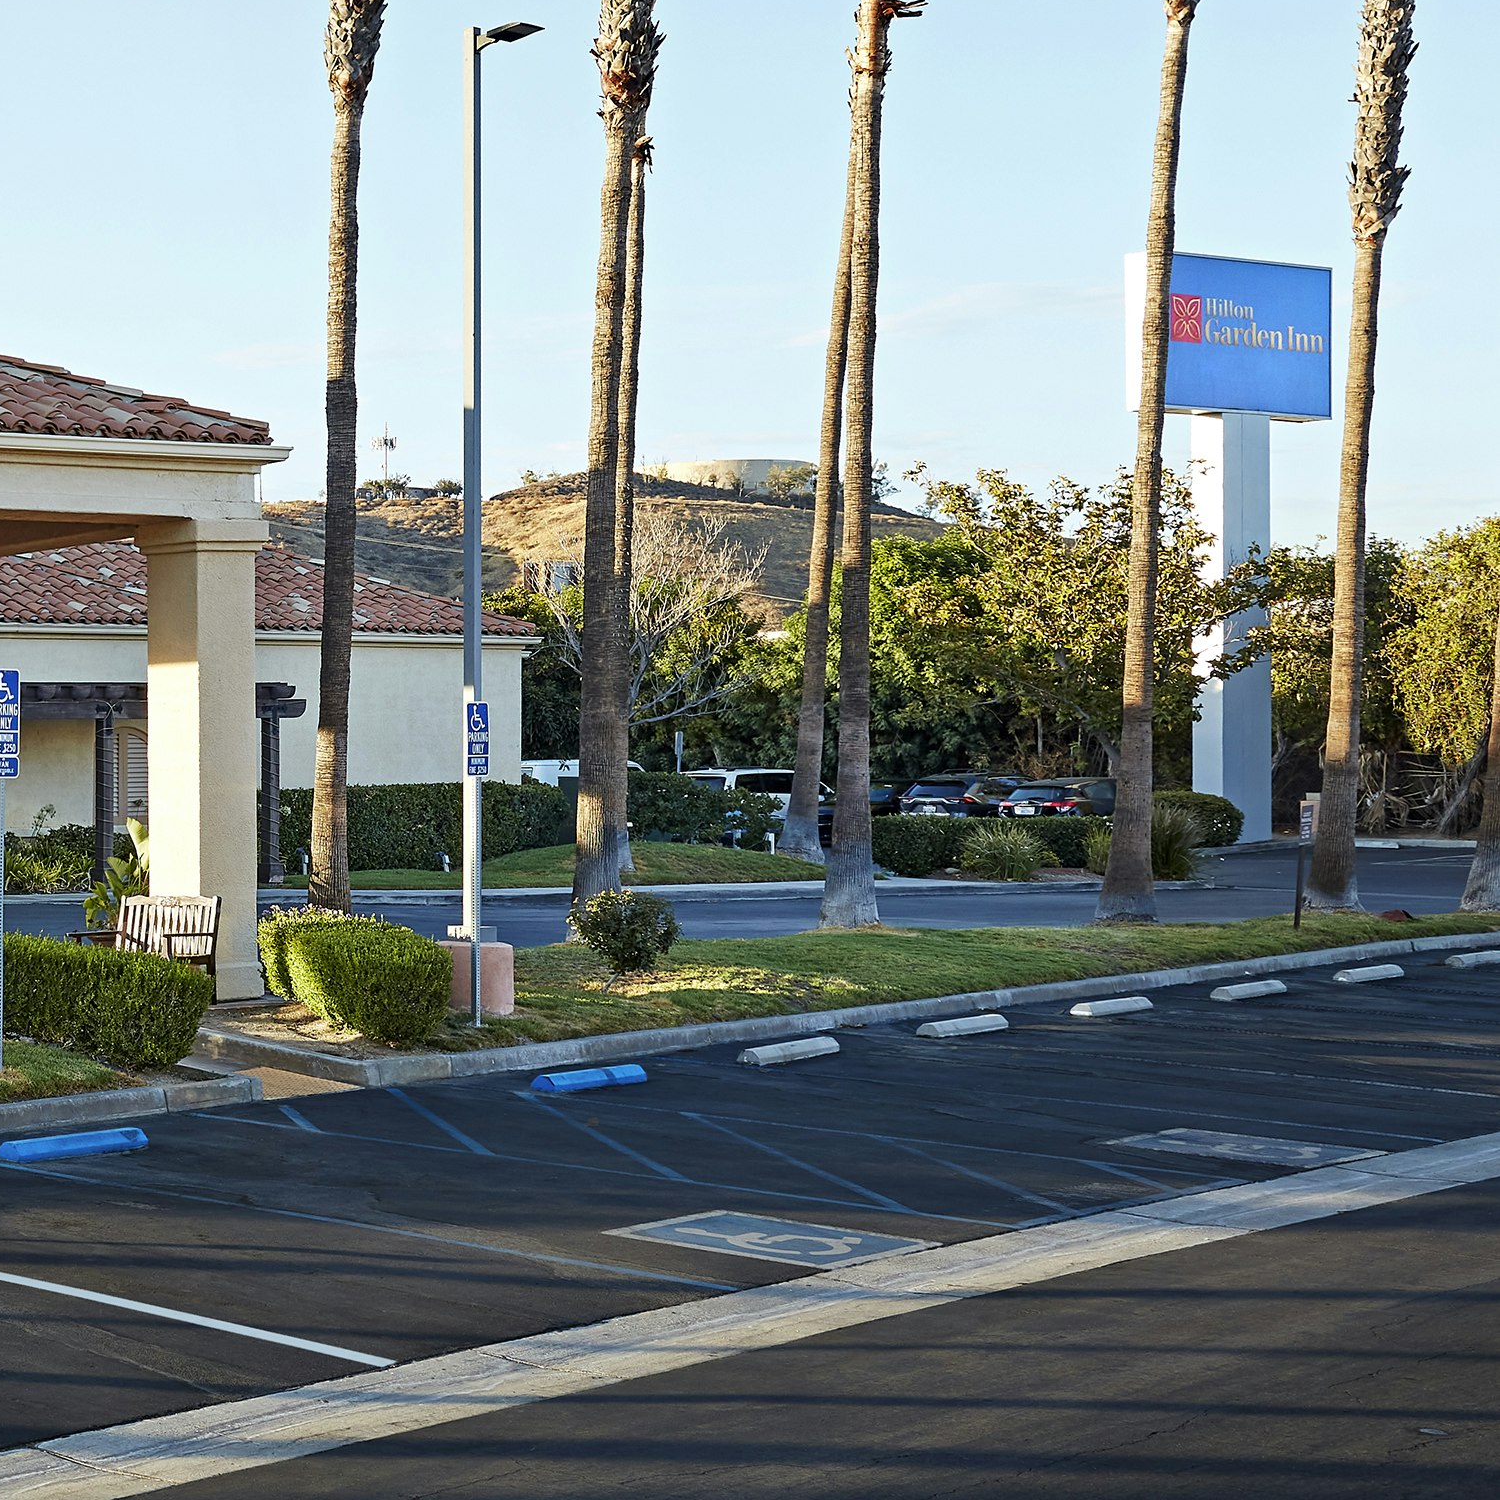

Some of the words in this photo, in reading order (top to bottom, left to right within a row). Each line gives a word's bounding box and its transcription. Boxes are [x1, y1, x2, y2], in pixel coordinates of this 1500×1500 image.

[1206, 298, 1254, 319] Hilton
[1205, 318, 1282, 350] Garden
[1287, 325, 1323, 354] Inn
[468, 732, 488, 742] PARKING
[472, 744, 484, 754] ONLY
